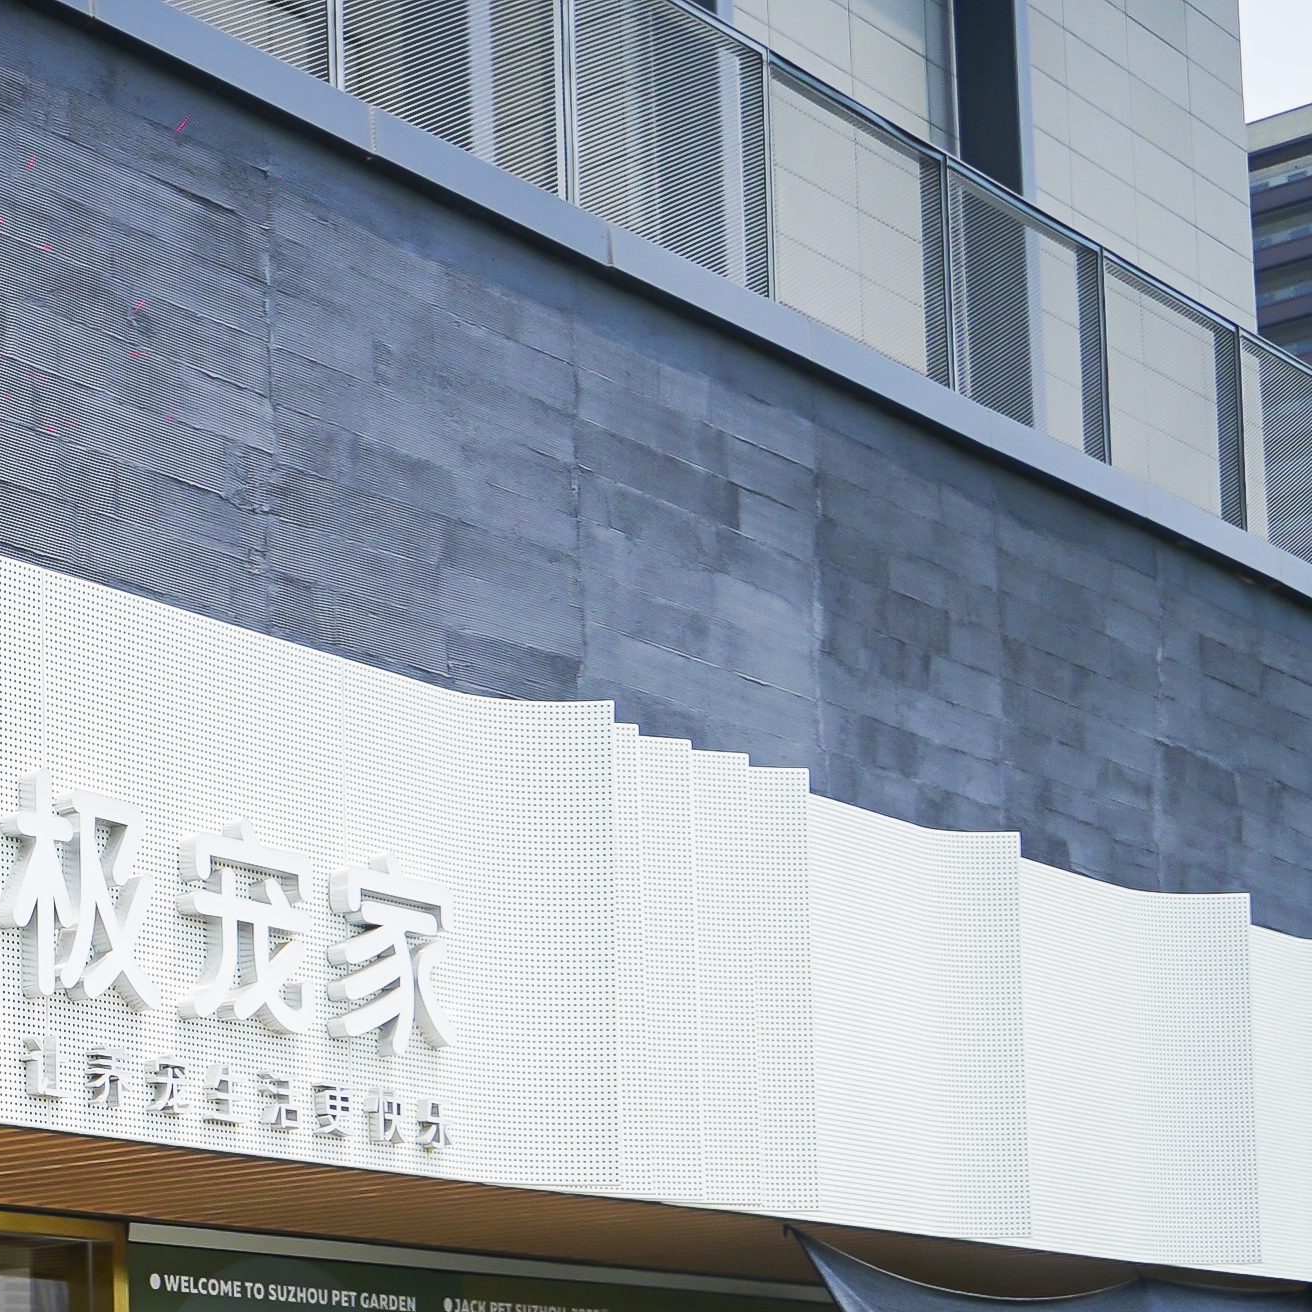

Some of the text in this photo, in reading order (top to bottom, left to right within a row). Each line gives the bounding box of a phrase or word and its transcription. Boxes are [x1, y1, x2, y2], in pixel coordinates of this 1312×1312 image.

[20, 1036, 456, 1151] 让养宠生活更快乐
[163, 1274, 417, 1312] WELCOME TO SUZHOU PET GARDEN
